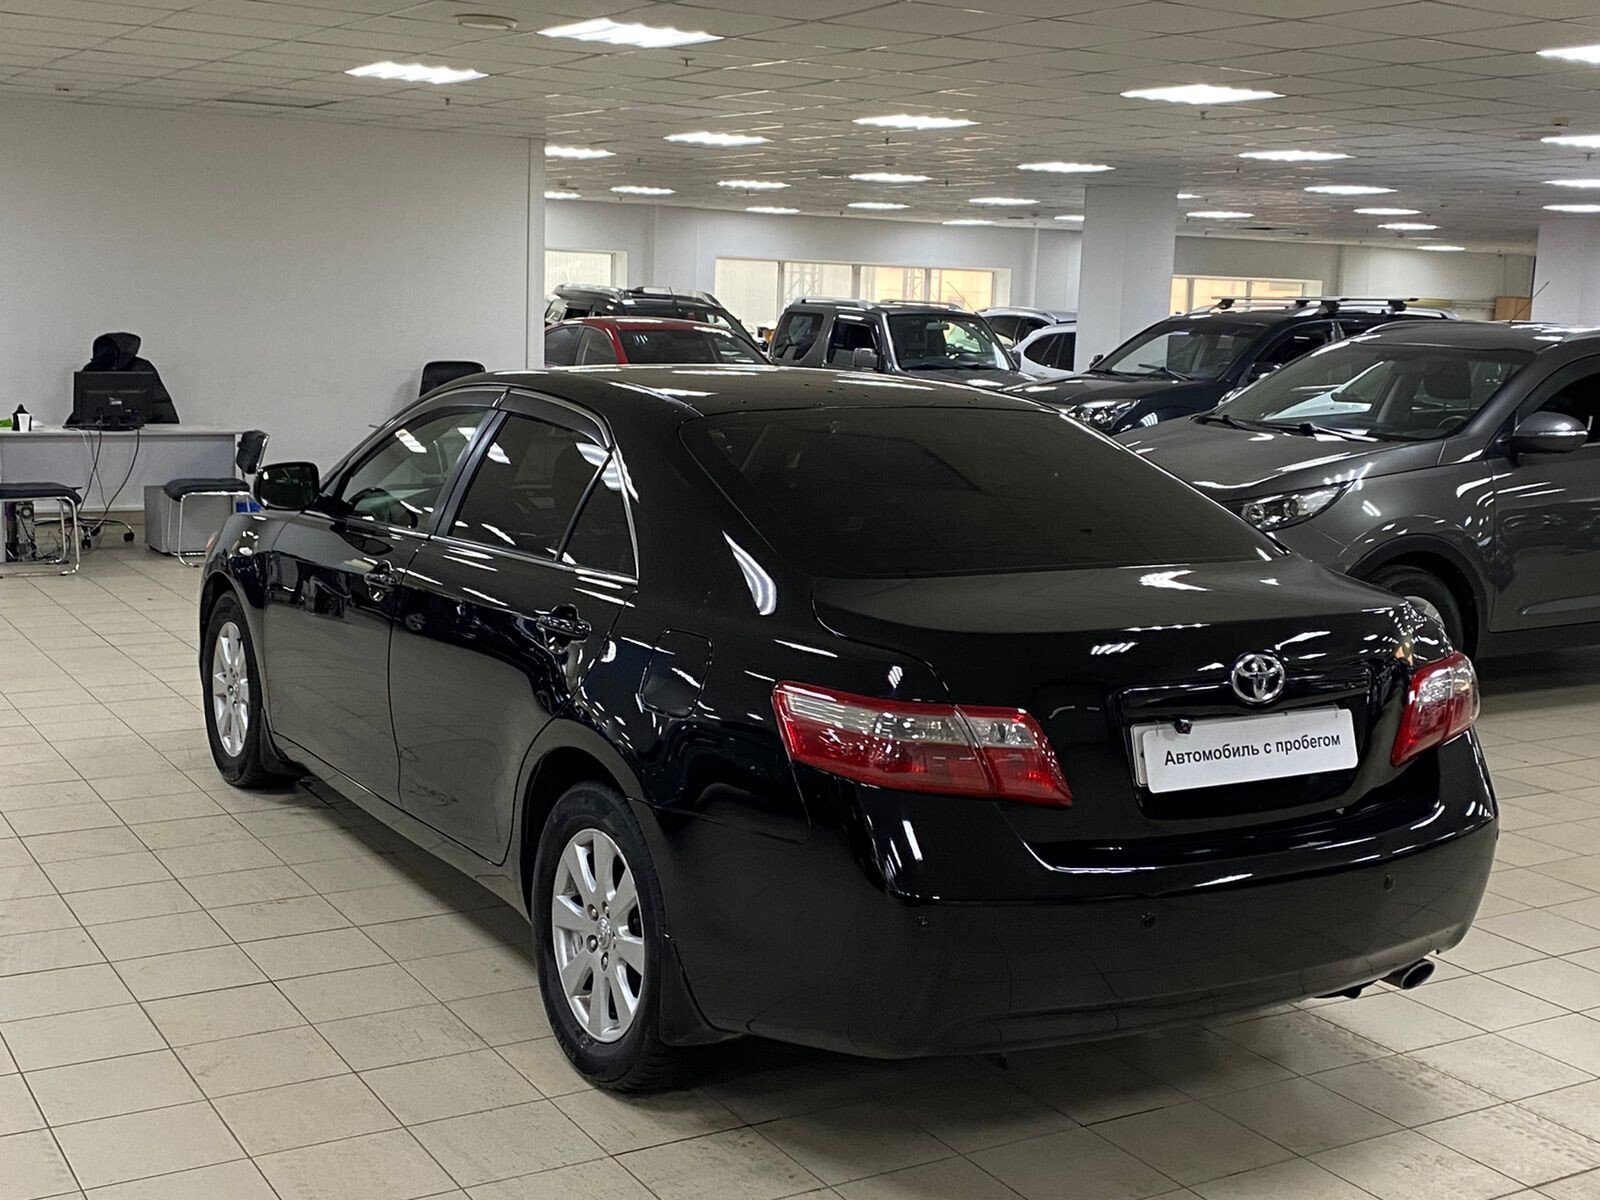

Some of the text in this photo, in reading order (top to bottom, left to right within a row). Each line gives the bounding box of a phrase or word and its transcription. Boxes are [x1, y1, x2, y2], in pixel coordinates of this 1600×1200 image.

[1164, 734, 1341, 766] Автомобиль с пробегом
